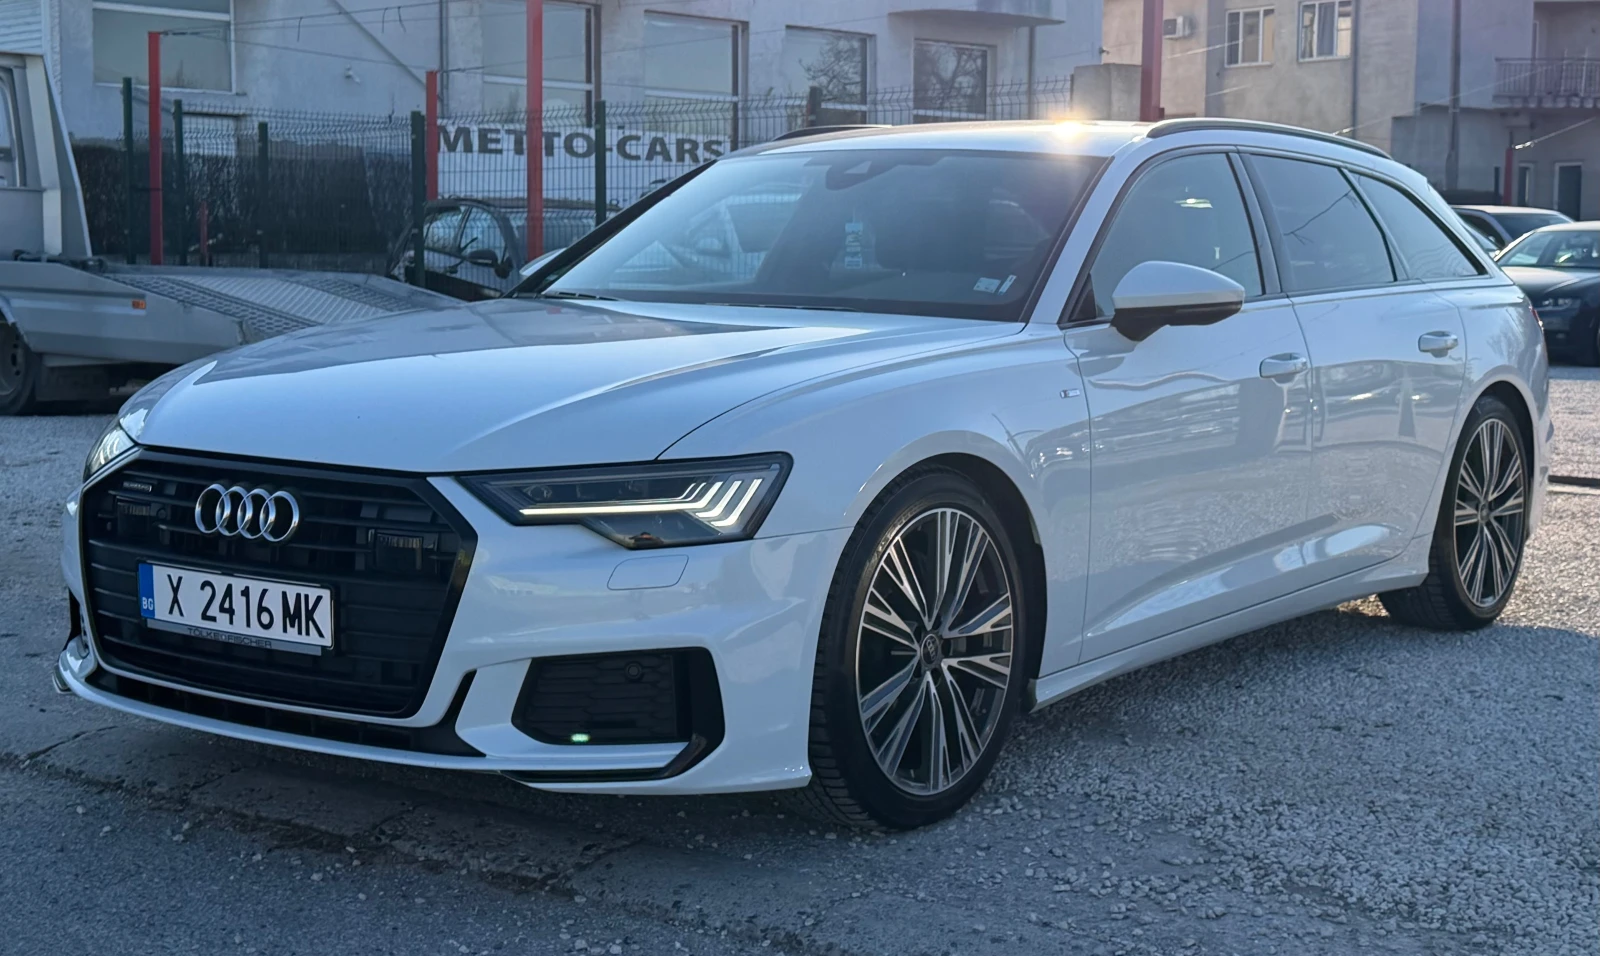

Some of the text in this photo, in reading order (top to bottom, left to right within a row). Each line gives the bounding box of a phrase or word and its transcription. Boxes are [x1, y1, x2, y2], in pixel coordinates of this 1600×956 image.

[142, 597, 154, 611] BG
[167, 574, 325, 638] X 2416 MK
